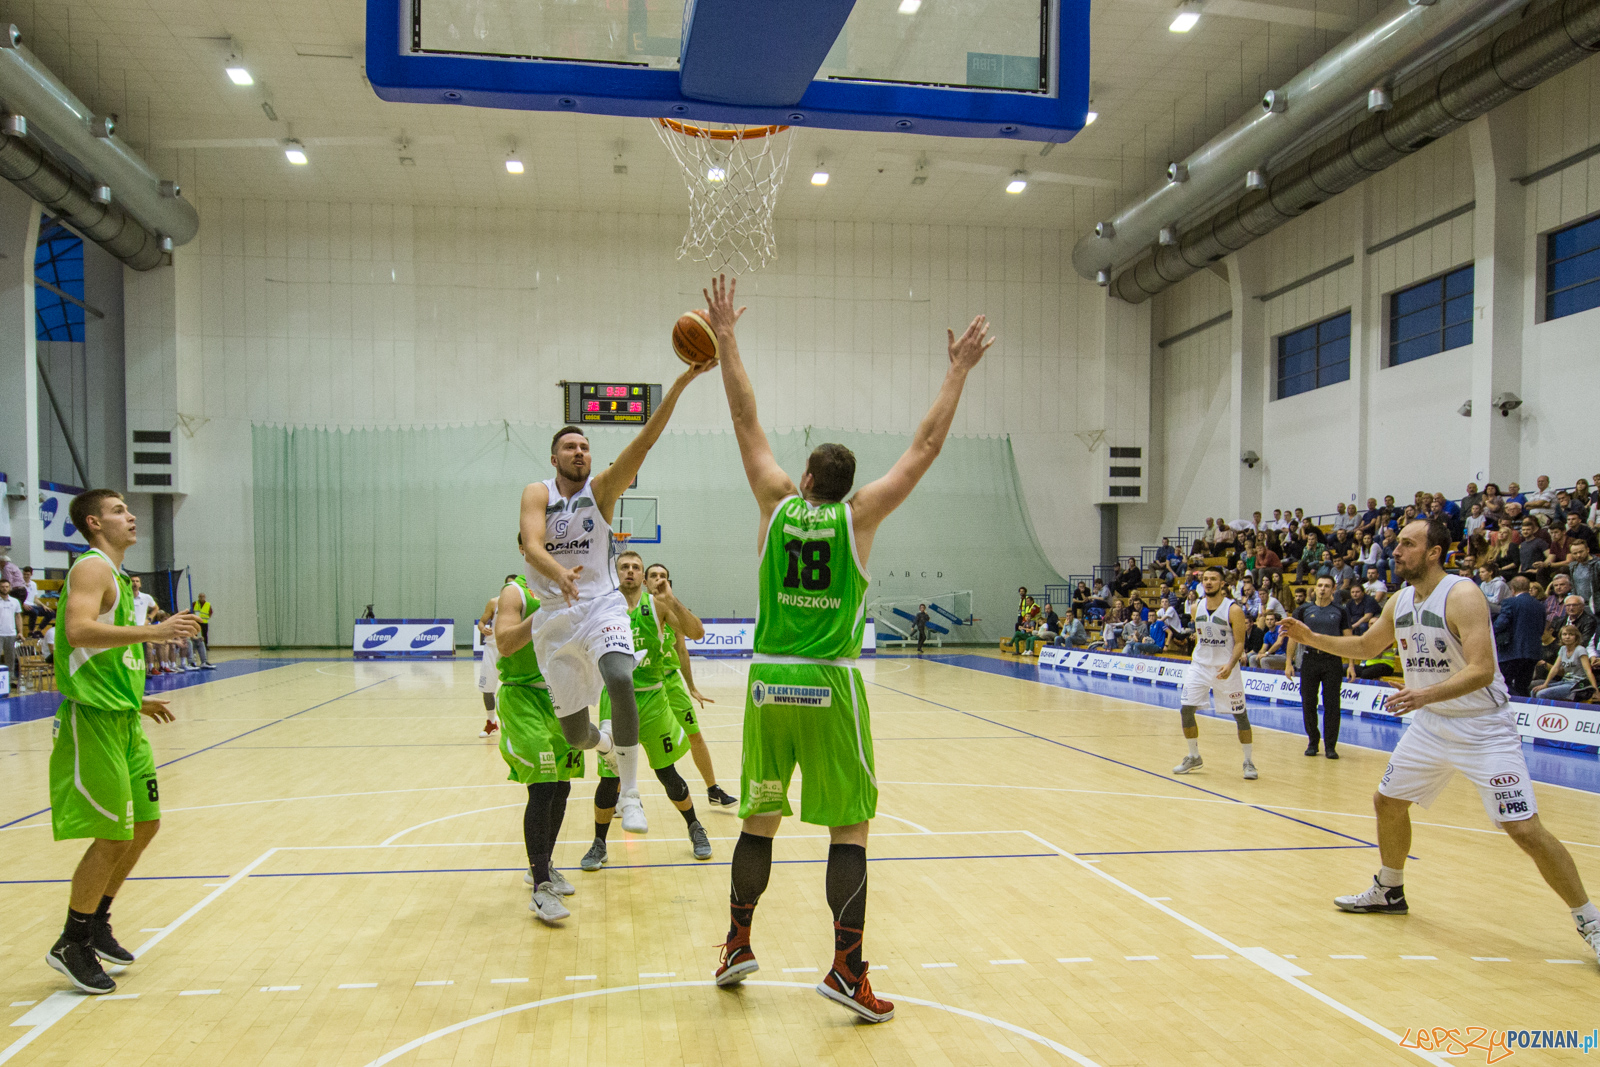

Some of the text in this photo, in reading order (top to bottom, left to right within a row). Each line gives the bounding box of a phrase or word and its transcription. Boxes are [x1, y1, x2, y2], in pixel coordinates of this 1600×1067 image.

[610, 401, 618, 410] 3
[1476, 471, 1483, 481] C
[555, 519, 569, 539] 9
[782, 539, 832, 590] 18
[777, 591, 842, 609] PRUSZKÓW
[641, 605, 650, 616] 6
[367, 633, 392, 642] atrem
[415, 633, 439, 642] atrem
[1412, 632, 1430, 653] 12
[1164, 668, 1183, 678] NICKEL
[767, 686, 830, 697] ELEKTROBUD
[1280, 681, 1302, 692] BIOF
[774, 696, 823, 705] INVESTMENT
[685, 711, 695, 724] 4
[1541, 716, 1563, 729] KIA
[662, 736, 673, 753] 6
[565, 750, 583, 768] 14
[1494, 774, 1516, 786] KIA
[146, 779, 159, 802] 8
[1494, 789, 1524, 800] DELIK
[1505, 801, 1528, 814] PBG
